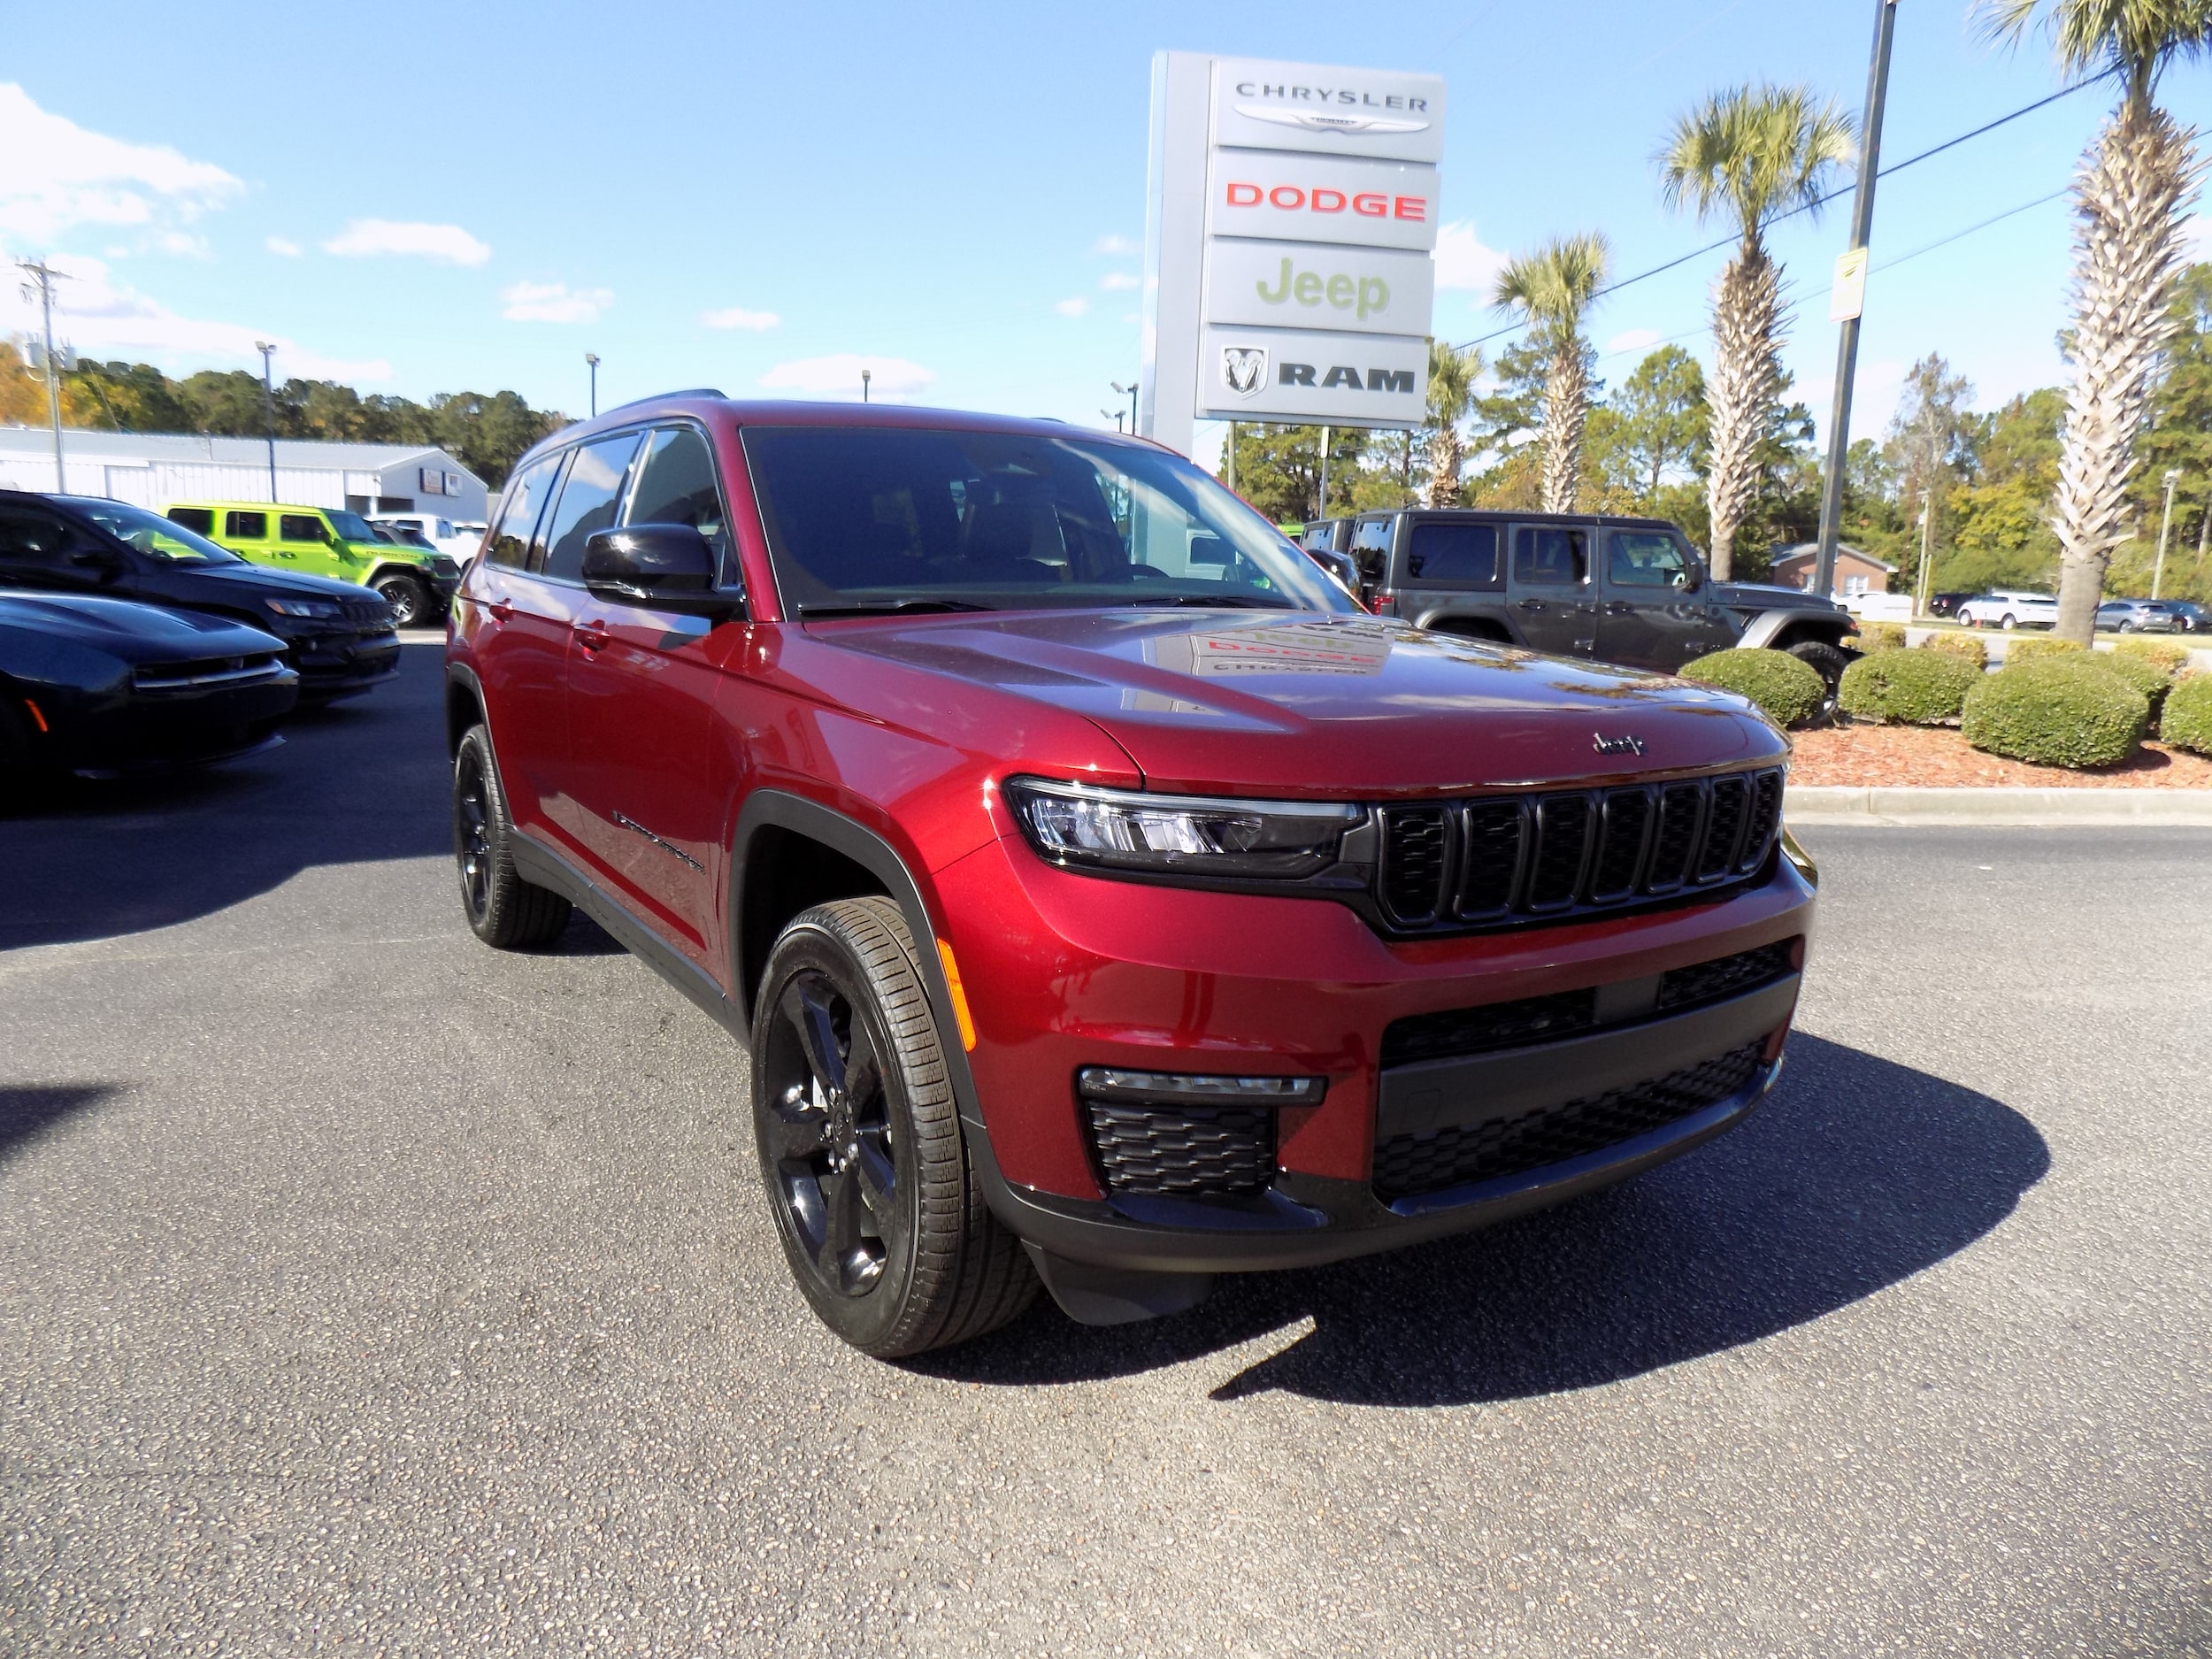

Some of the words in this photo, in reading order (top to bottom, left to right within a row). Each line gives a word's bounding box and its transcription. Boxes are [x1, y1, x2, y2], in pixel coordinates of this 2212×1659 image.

[1236, 83, 1427, 112] CHRYSLER
[1226, 183, 1425, 222] DODGE
[1256, 257, 1390, 320] Jeep
[1279, 363, 1415, 394] RAM
[365, 550, 418, 559] RUBICON
[1593, 732, 1646, 757] Jeep
